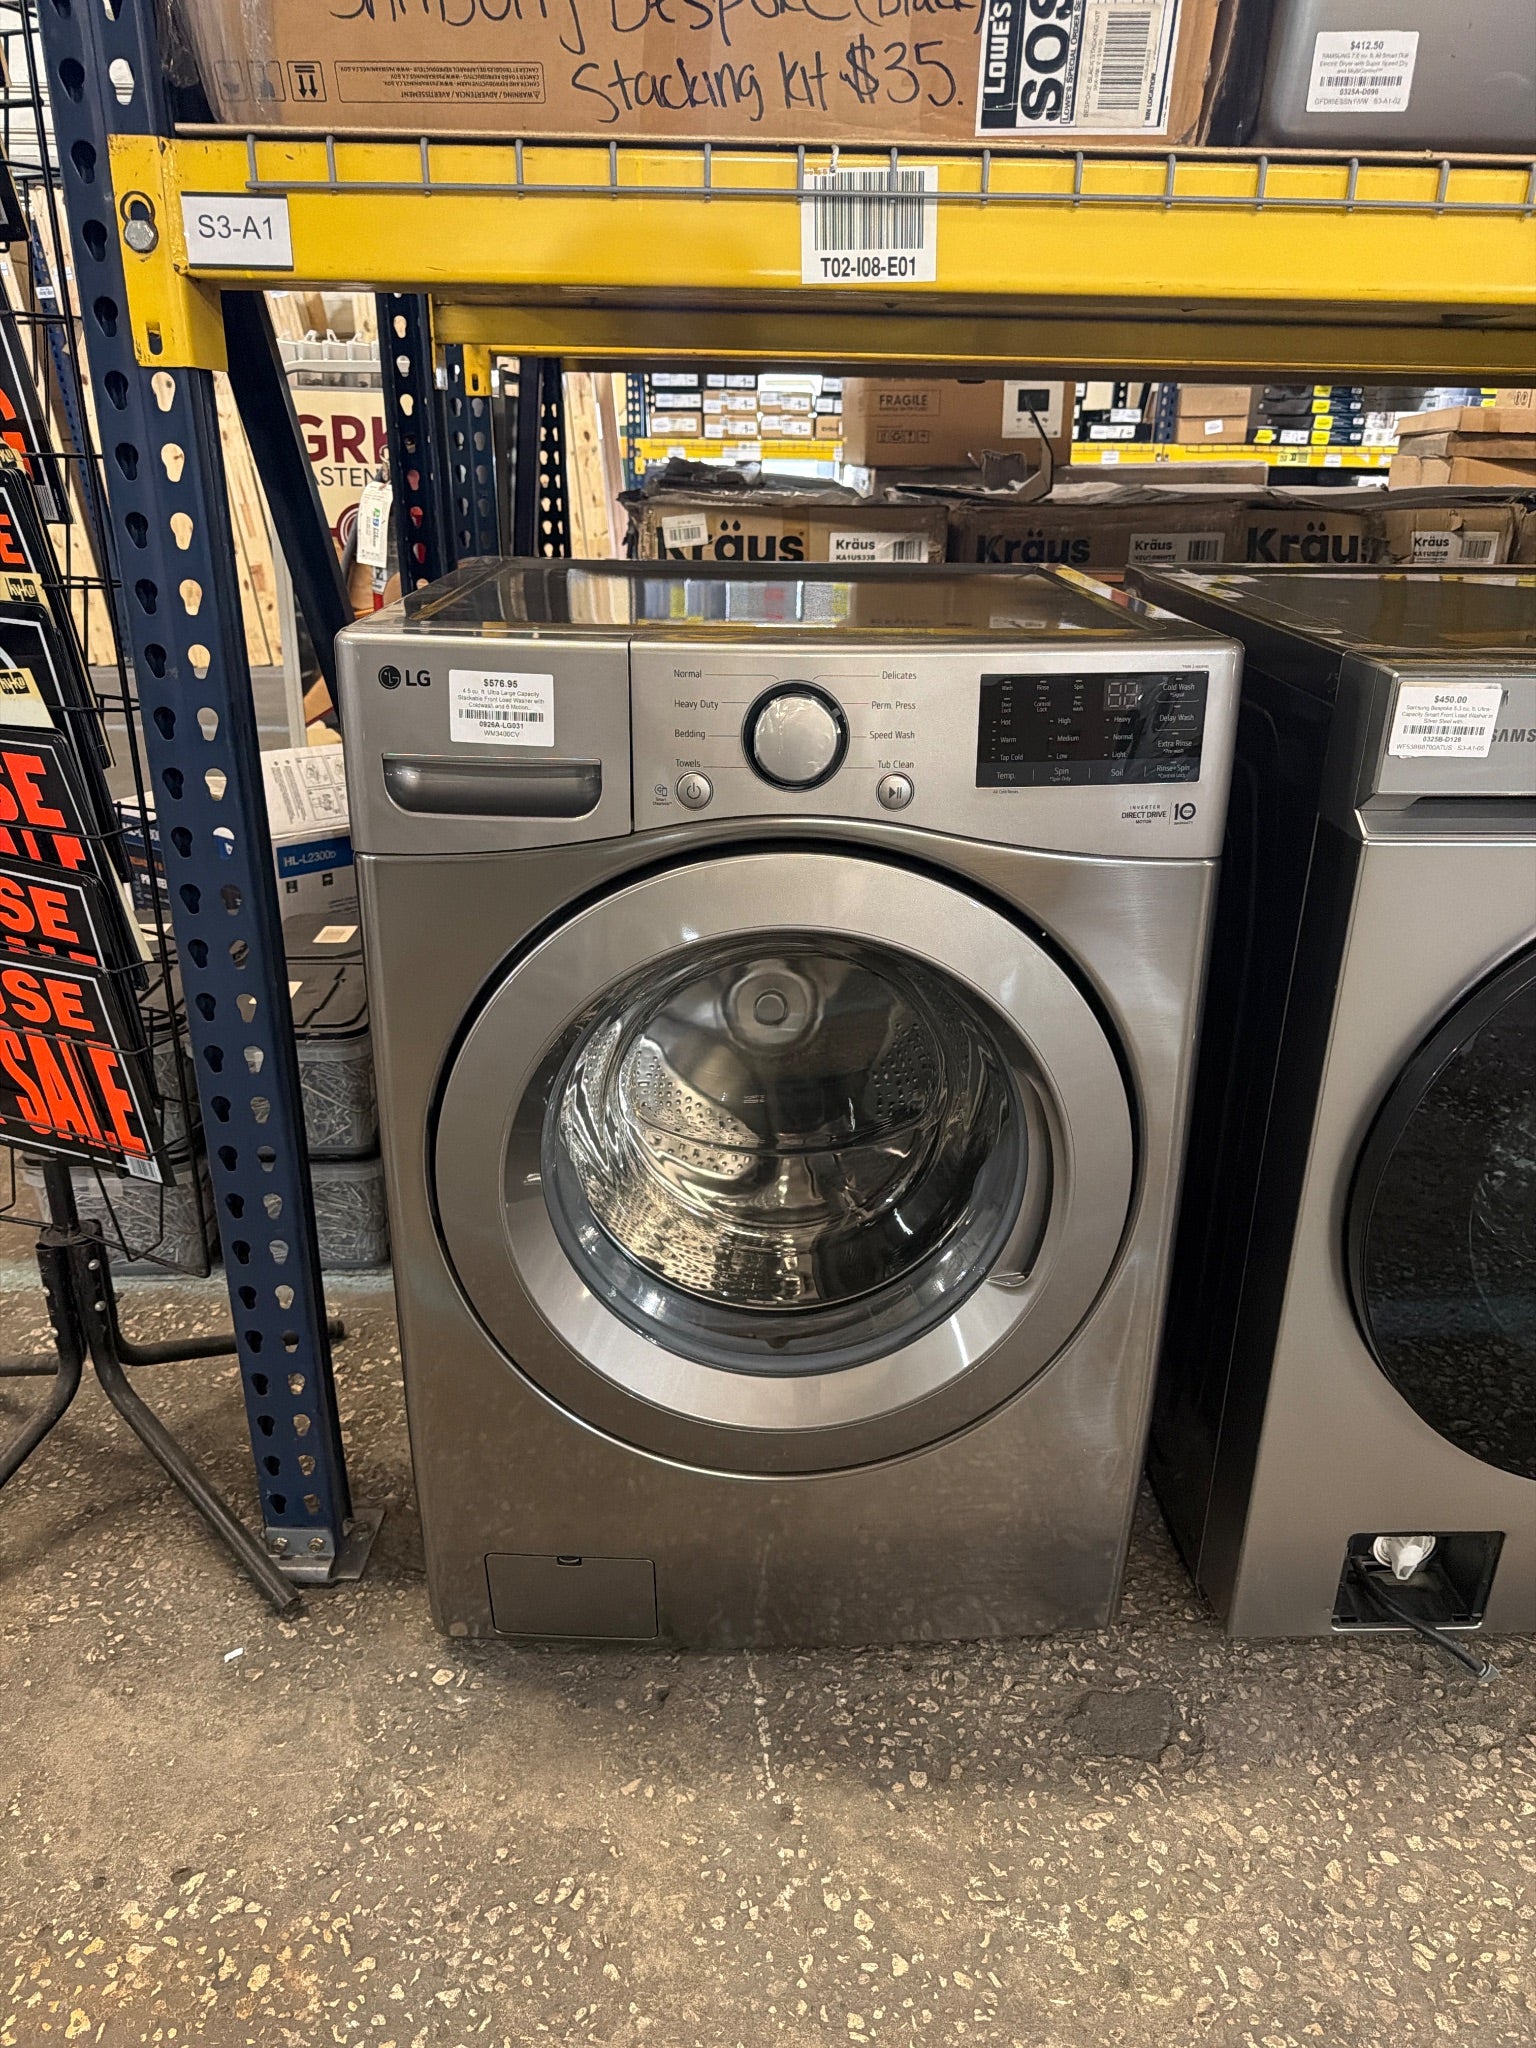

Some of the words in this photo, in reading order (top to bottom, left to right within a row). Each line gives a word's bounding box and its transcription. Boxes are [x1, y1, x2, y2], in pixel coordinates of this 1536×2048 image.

[1070, 14, 1081, 45] ORDER
[984, 1, 1012, 94] LOWE'S
[1351, 40, 1384, 50] $412.50
[1066, 48, 1077, 83] SPECIAL
[455, 91, 498, 99] ADVERTENCIA
[503, 91, 534, 99] WARNING
[571, 57, 765, 123] Stacking
[1147, 73, 1156, 107] LOCATION
[1062, 75, 1073, 121] LOWE'S
[198, 214, 272, 240] S3-A1
[820, 256, 916, 277] T02-I08-E01
[879, 394, 928, 406] FRAGILE
[835, 538, 876, 550] Kräus
[976, 528, 1092, 563] Kräus
[1135, 538, 1173, 552] Kräus
[1248, 520, 1369, 564] Kräu
[1413, 536, 1450, 548] Kräus
[405, 669, 431, 687] LG
[674, 669, 702, 679] Normal
[882, 671, 917, 680] Delicates
[483, 678, 518, 688] $576.95
[1163, 683, 1178, 691] Cold
[1179, 682, 1195, 691] Wash
[674, 699, 698, 710] Heavy
[700, 699, 719, 710] Duty
[1434, 695, 1468, 704] $450.00
[871, 701, 893, 710] Perm.
[895, 701, 916, 710] Press
[1000, 718, 1011, 726] Hot
[1057, 717, 1072, 725] High
[1114, 716, 1131, 724] Heavy
[1159, 714, 1176, 723] Delay
[1177, 713, 1195, 722] Wash
[479, 721, 524, 729] 0926A-LG031
[484, 730, 520, 738] WM3400CV
[674, 729, 706, 741] Bedding
[869, 730, 894, 741] Speed
[895, 730, 915, 739] Wash
[1113, 733, 1133, 741] Normal
[1000, 736, 1017, 744] Warm
[1157, 740, 1174, 748] Extra
[1175, 739, 1193, 747] Rinse
[1000, 754, 1010, 762] Tap
[1112, 751, 1127, 759] Light
[675, 759, 701, 768] Towels
[877, 760, 892, 769] Tub
[893, 760, 915, 769] Clean
[1177, 764, 1191, 772] Spin
[997, 771, 1016, 781] Temp.
[1054, 767, 1070, 776] Spin
[1111, 768, 1124, 777] Soil
[1121, 811, 1146, 819] DIRECT
[1174, 802, 1197, 820] 10
[0, 1019, 150, 1160] SALE
